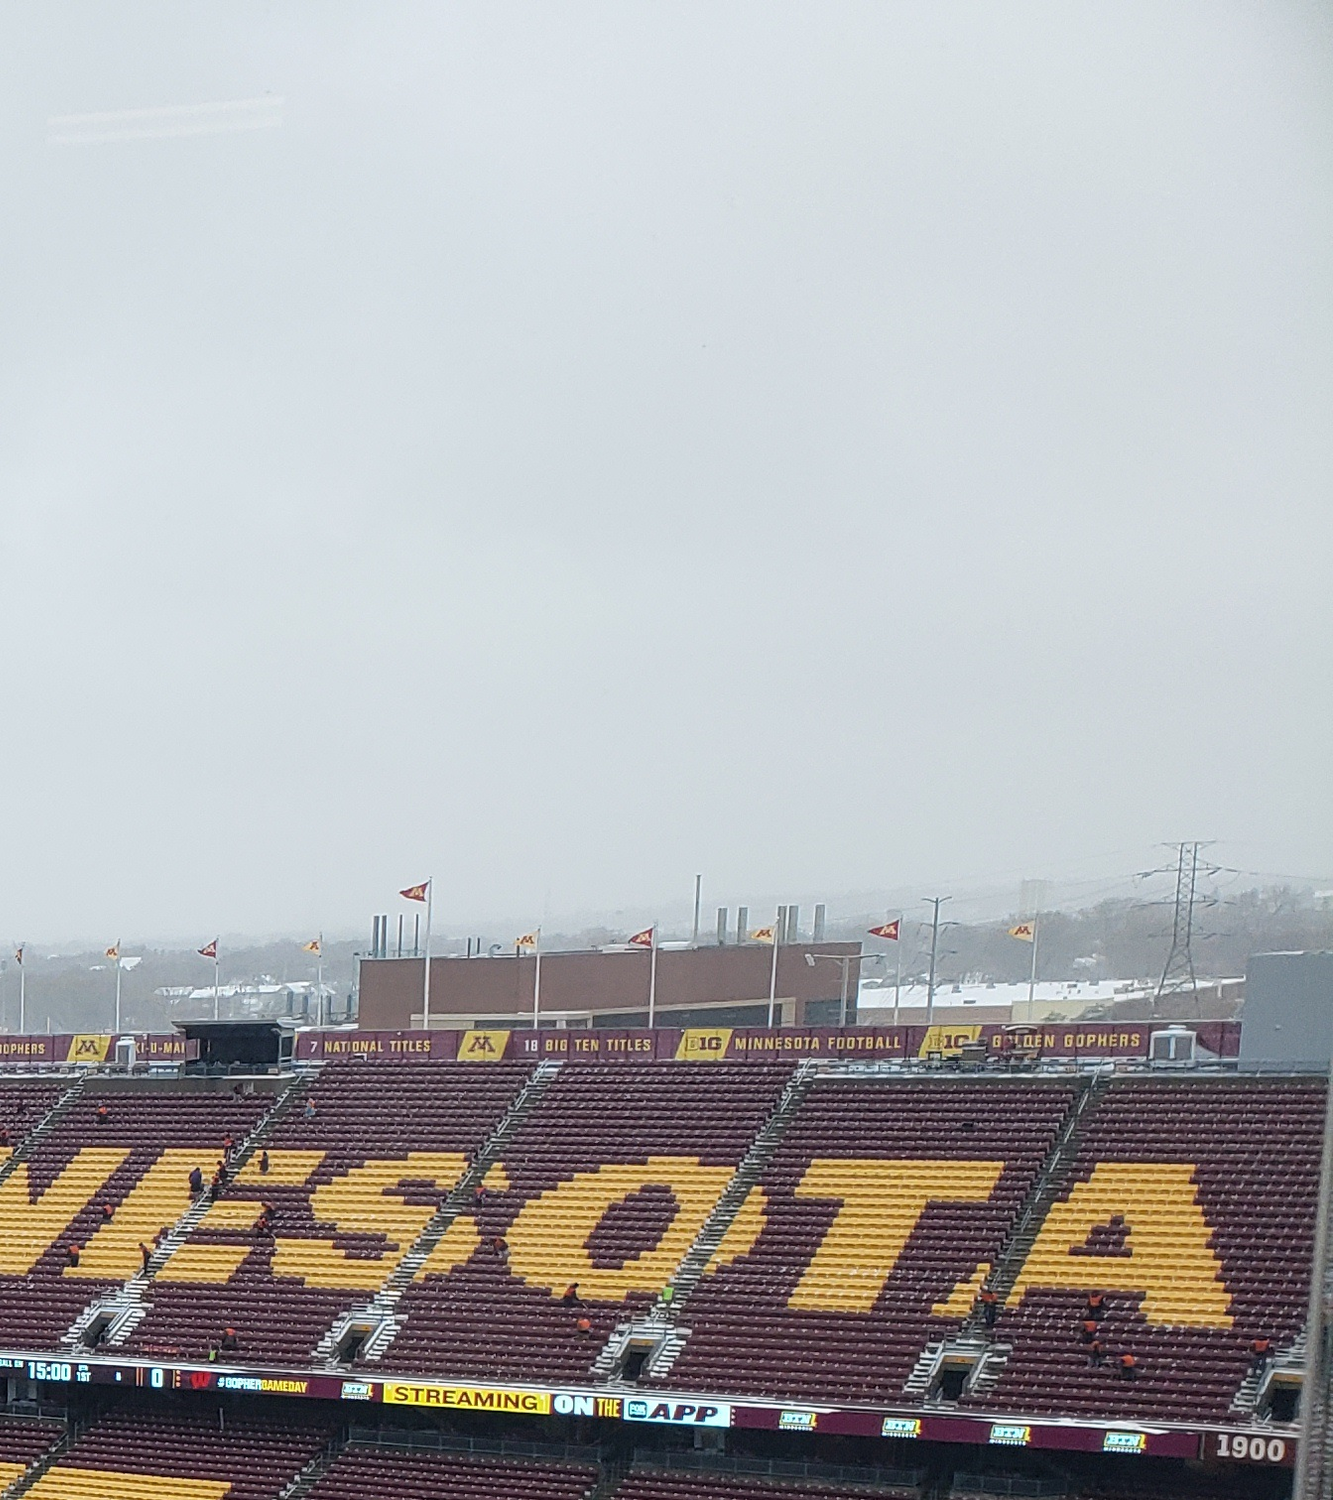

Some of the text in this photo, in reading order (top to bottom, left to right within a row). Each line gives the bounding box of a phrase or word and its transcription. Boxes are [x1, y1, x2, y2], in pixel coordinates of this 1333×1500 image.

[310, 1039, 431, 1053] 7 NATIONAL TITLES
[546, 1039, 567, 1051] BIG
[575, 1039, 599, 1051] TEN
[607, 1038, 652, 1051] TITLES
[735, 1037, 821, 1051] MINNESOTA
[828, 1035, 902, 1050] FOOTBALL
[1064, 1033, 1140, 1048] GOPHERS
[28, 1361, 72, 1381] 15:00
[76, 1371, 91, 1382] 1ST
[151, 1368, 164, 1388] 0
[394, 1386, 538, 1411] STREAMING
[553, 1394, 595, 1416] ON
[597, 1397, 621, 1418] THE
[648, 1403, 719, 1423] APP
[1216, 1434, 1285, 1463] 1900
